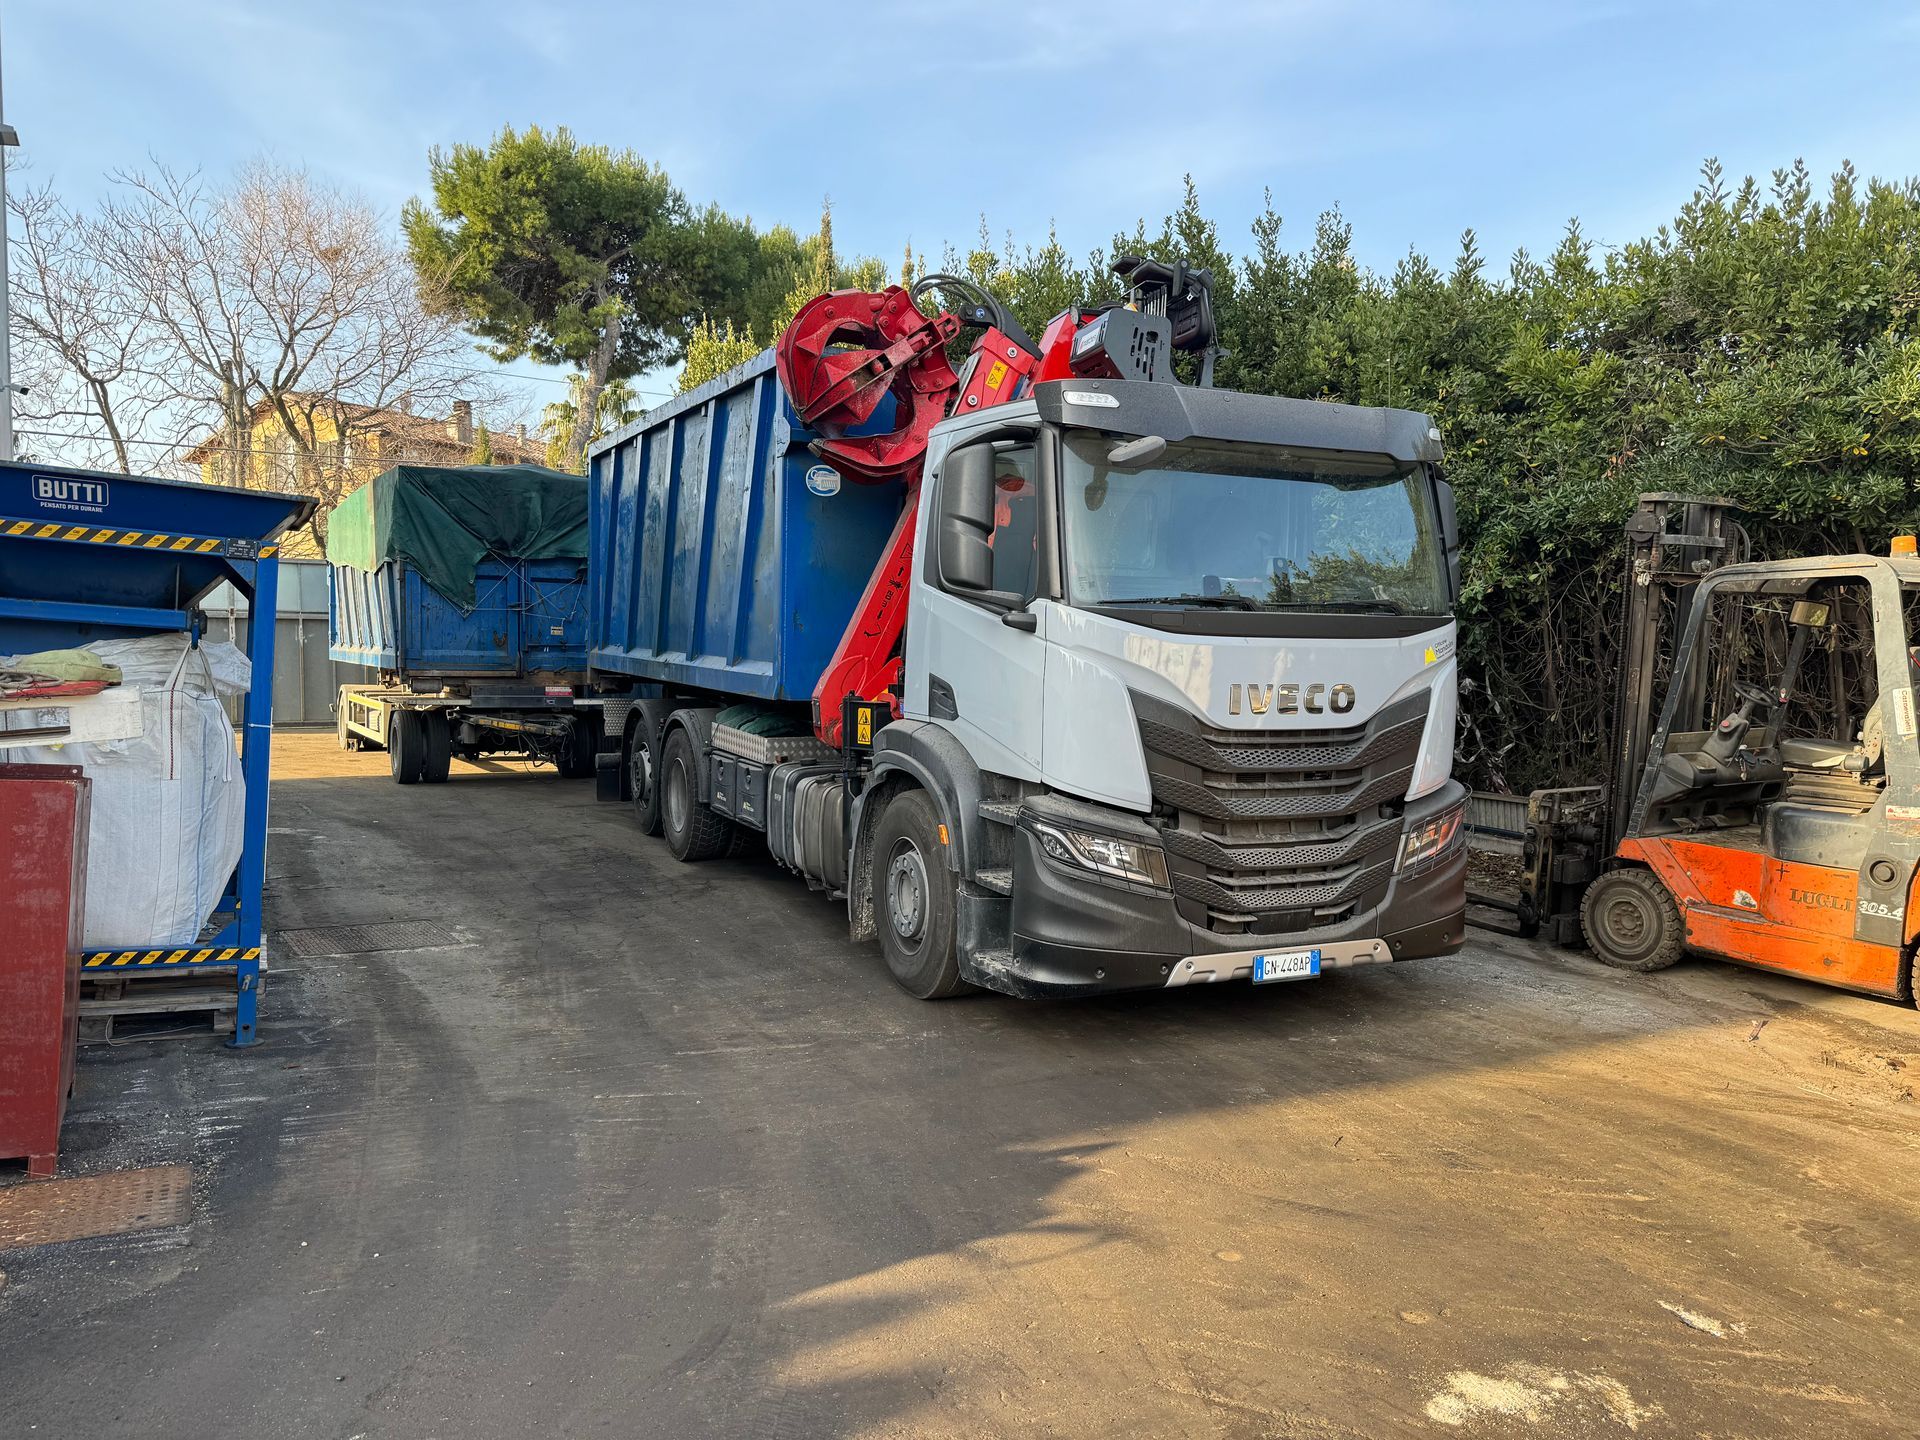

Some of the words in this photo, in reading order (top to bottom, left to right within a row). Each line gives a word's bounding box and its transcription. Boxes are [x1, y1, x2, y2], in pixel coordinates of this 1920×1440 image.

[39, 479, 102, 502] BUTTI
[40, 501, 67, 510] PENSATO
[885, 589, 894, 601] 20
[1228, 683, 1356, 715] IVECO
[1789, 888, 1853, 912] LUGLI
